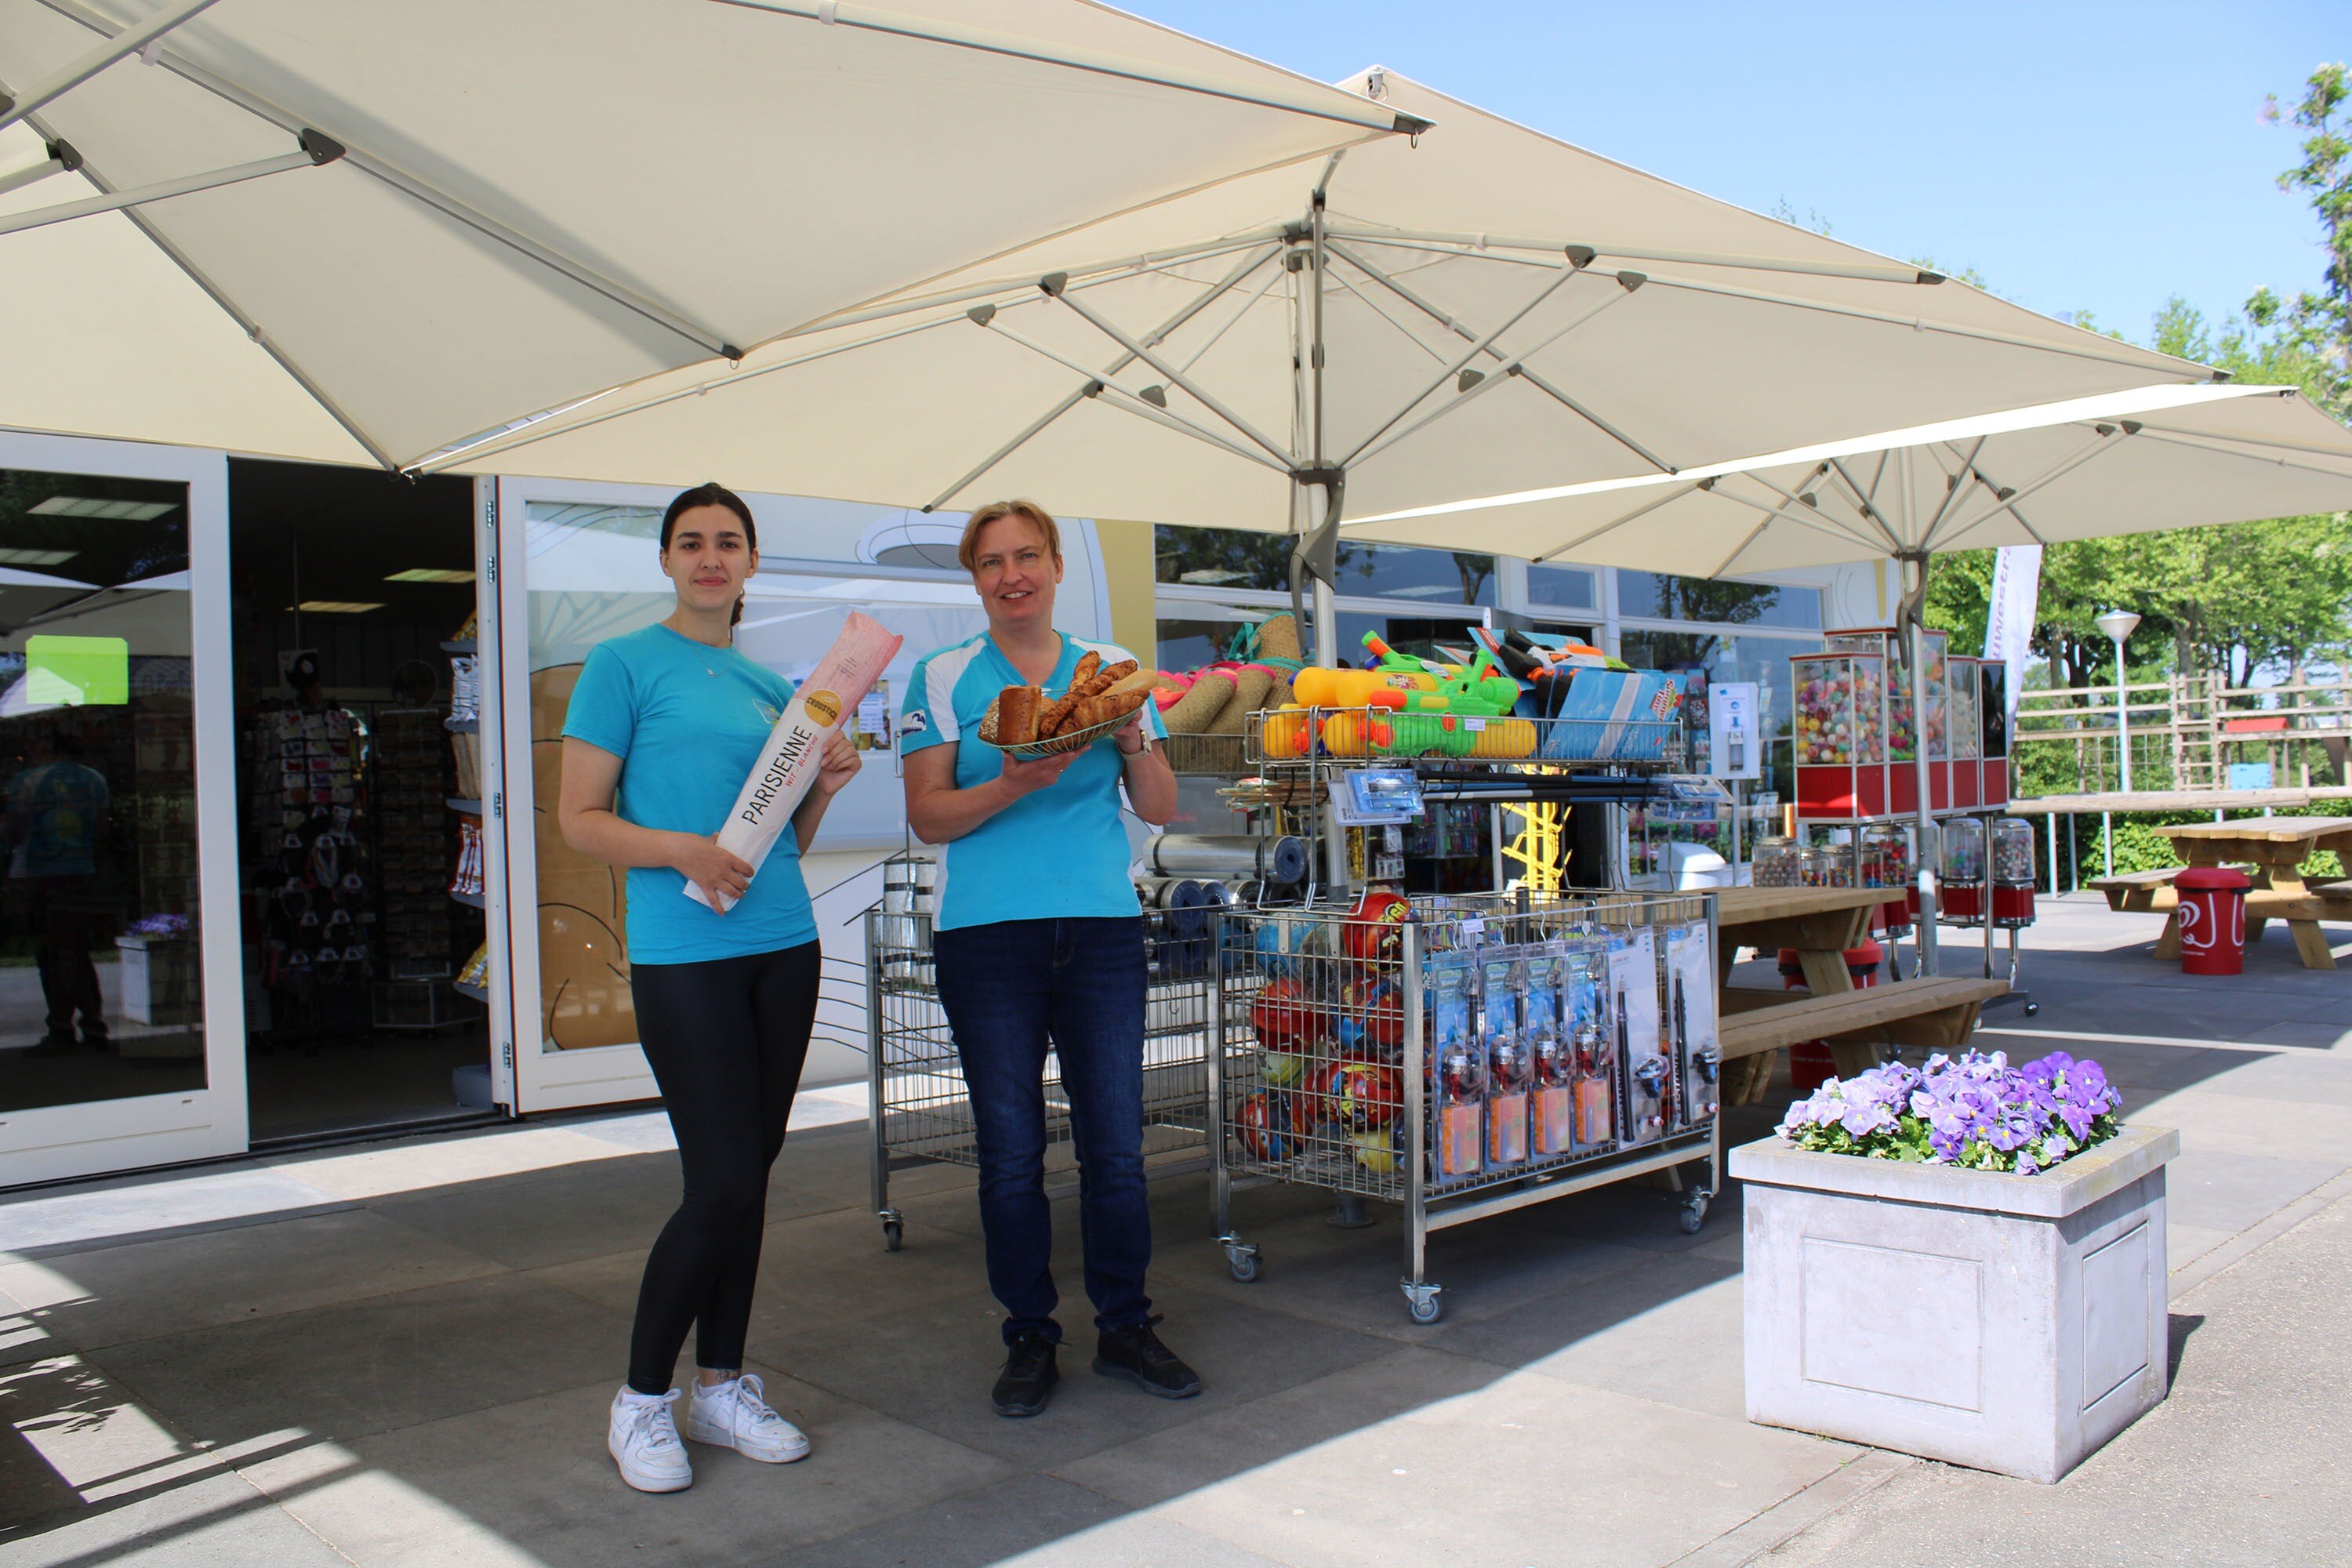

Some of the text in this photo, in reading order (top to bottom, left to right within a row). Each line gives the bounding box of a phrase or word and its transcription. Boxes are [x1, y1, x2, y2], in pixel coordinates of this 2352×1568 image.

[742, 725, 812, 825] PARISIENNE
[785, 772, 797, 787] WIT
[797, 735, 818, 768] BLANCHE
